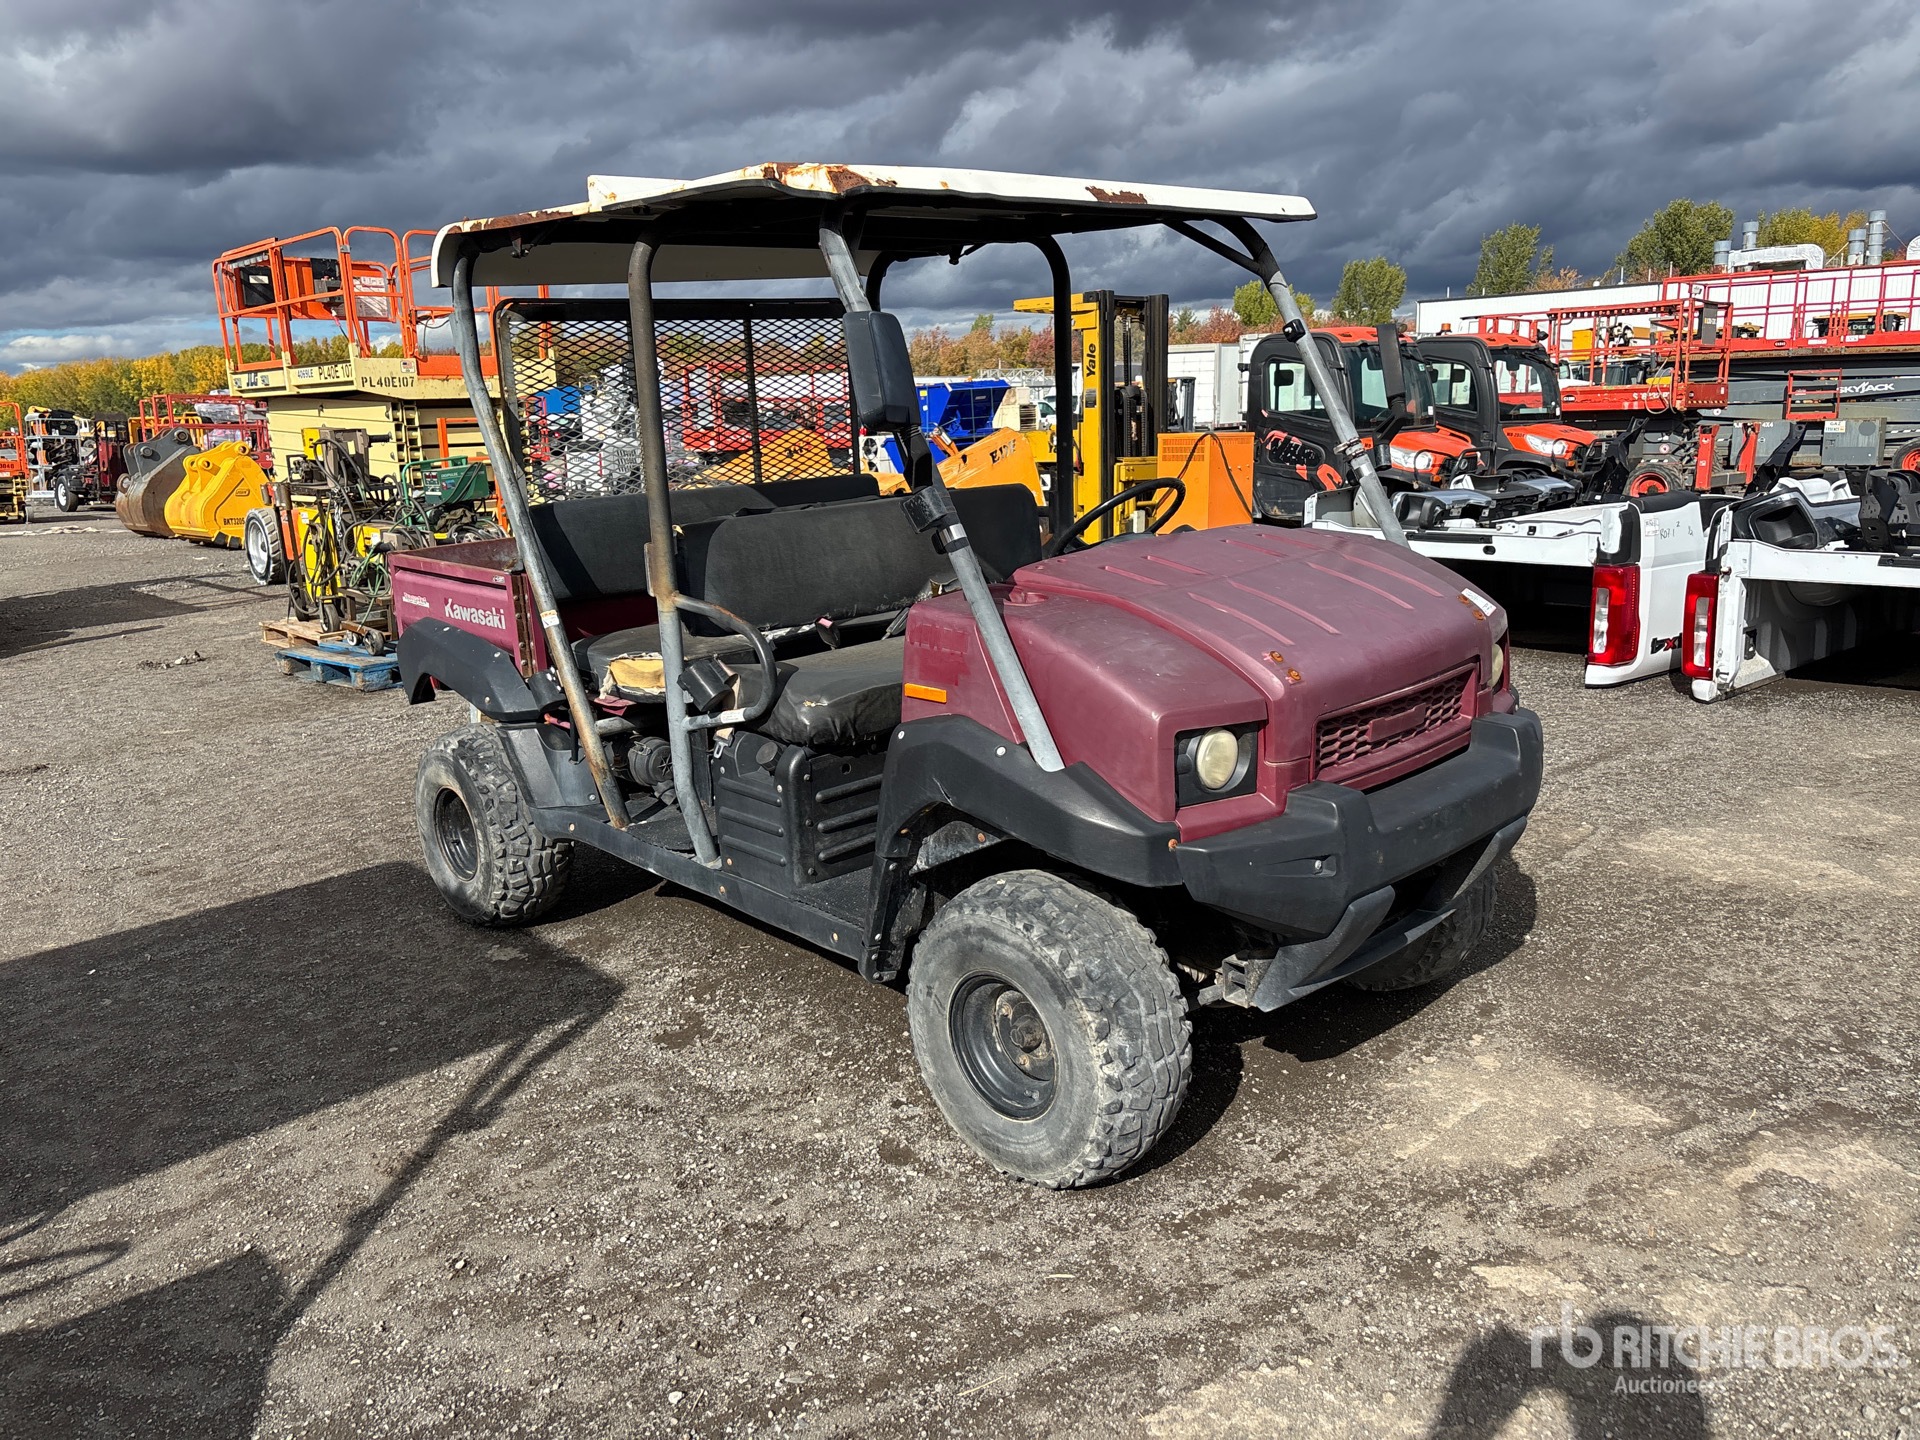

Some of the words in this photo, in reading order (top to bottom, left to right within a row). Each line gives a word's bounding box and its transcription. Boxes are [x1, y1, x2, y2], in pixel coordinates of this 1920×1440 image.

[1086, 343, 1096, 377] Yale
[246, 372, 258, 387] JLG
[1836, 381, 1895, 394] SKYJACK
[443, 597, 506, 630] Kawasaki
